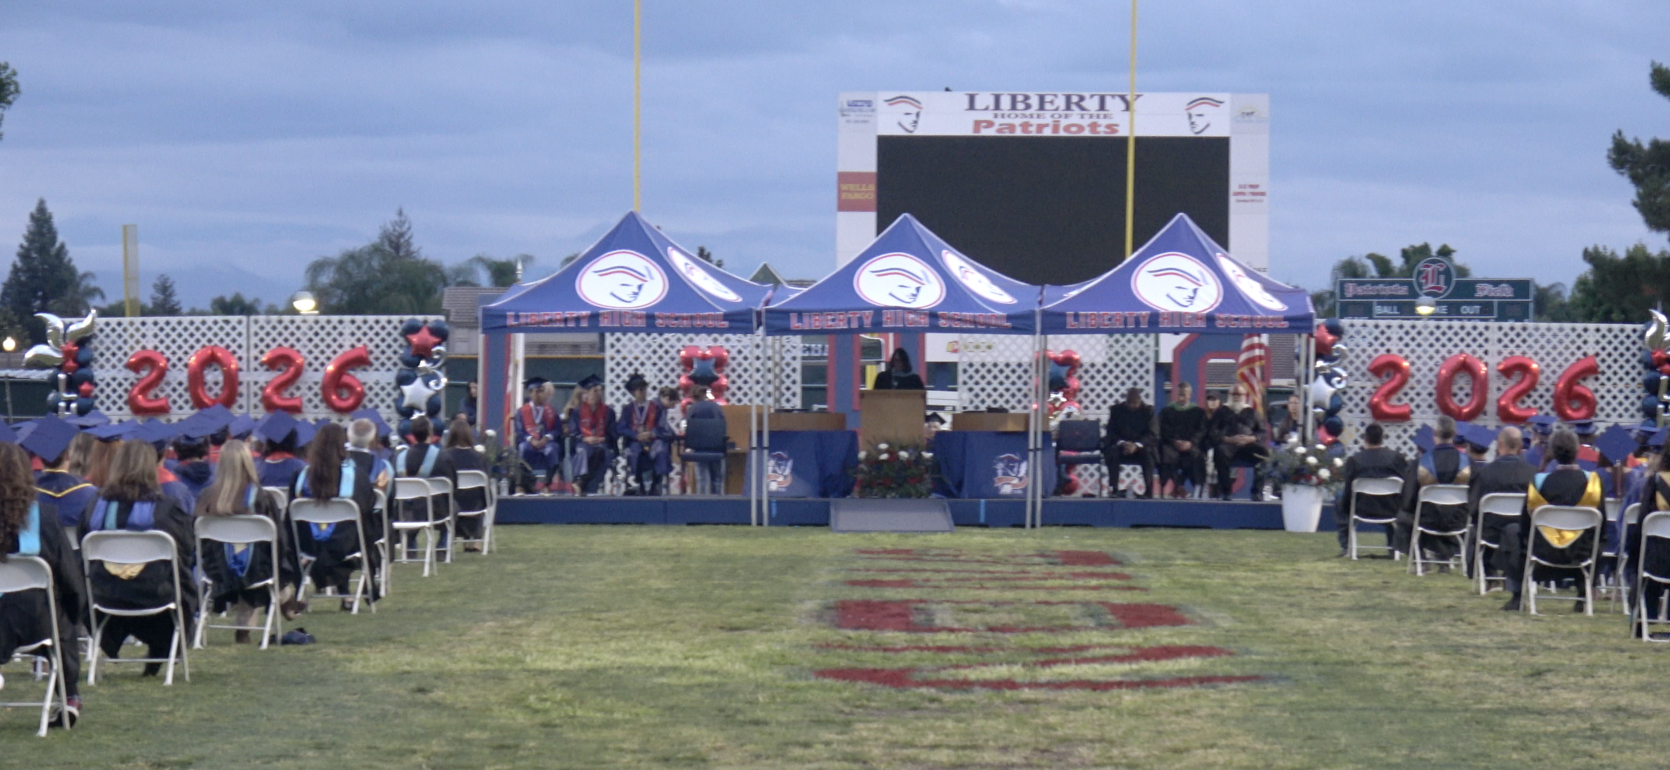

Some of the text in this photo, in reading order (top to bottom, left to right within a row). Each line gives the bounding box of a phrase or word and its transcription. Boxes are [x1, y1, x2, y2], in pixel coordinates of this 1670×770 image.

[965, 93, 1143, 112] LIBERTY
[993, 112, 1114, 120] HOME OF THE
[972, 119, 1119, 135] Patriots
[1375, 305, 1400, 315] BALL
[1460, 305, 1481, 314] OUT
[506, 310, 729, 329] LIBERTY HIGH SCHOOL
[789, 309, 1012, 330] LIBERTY HIGH SCHOOL
[1066, 311, 1290, 329] LIBERTY HIGH SCHOOL
[126, 344, 372, 416] 2026
[1368, 353, 1599, 422] 2026
